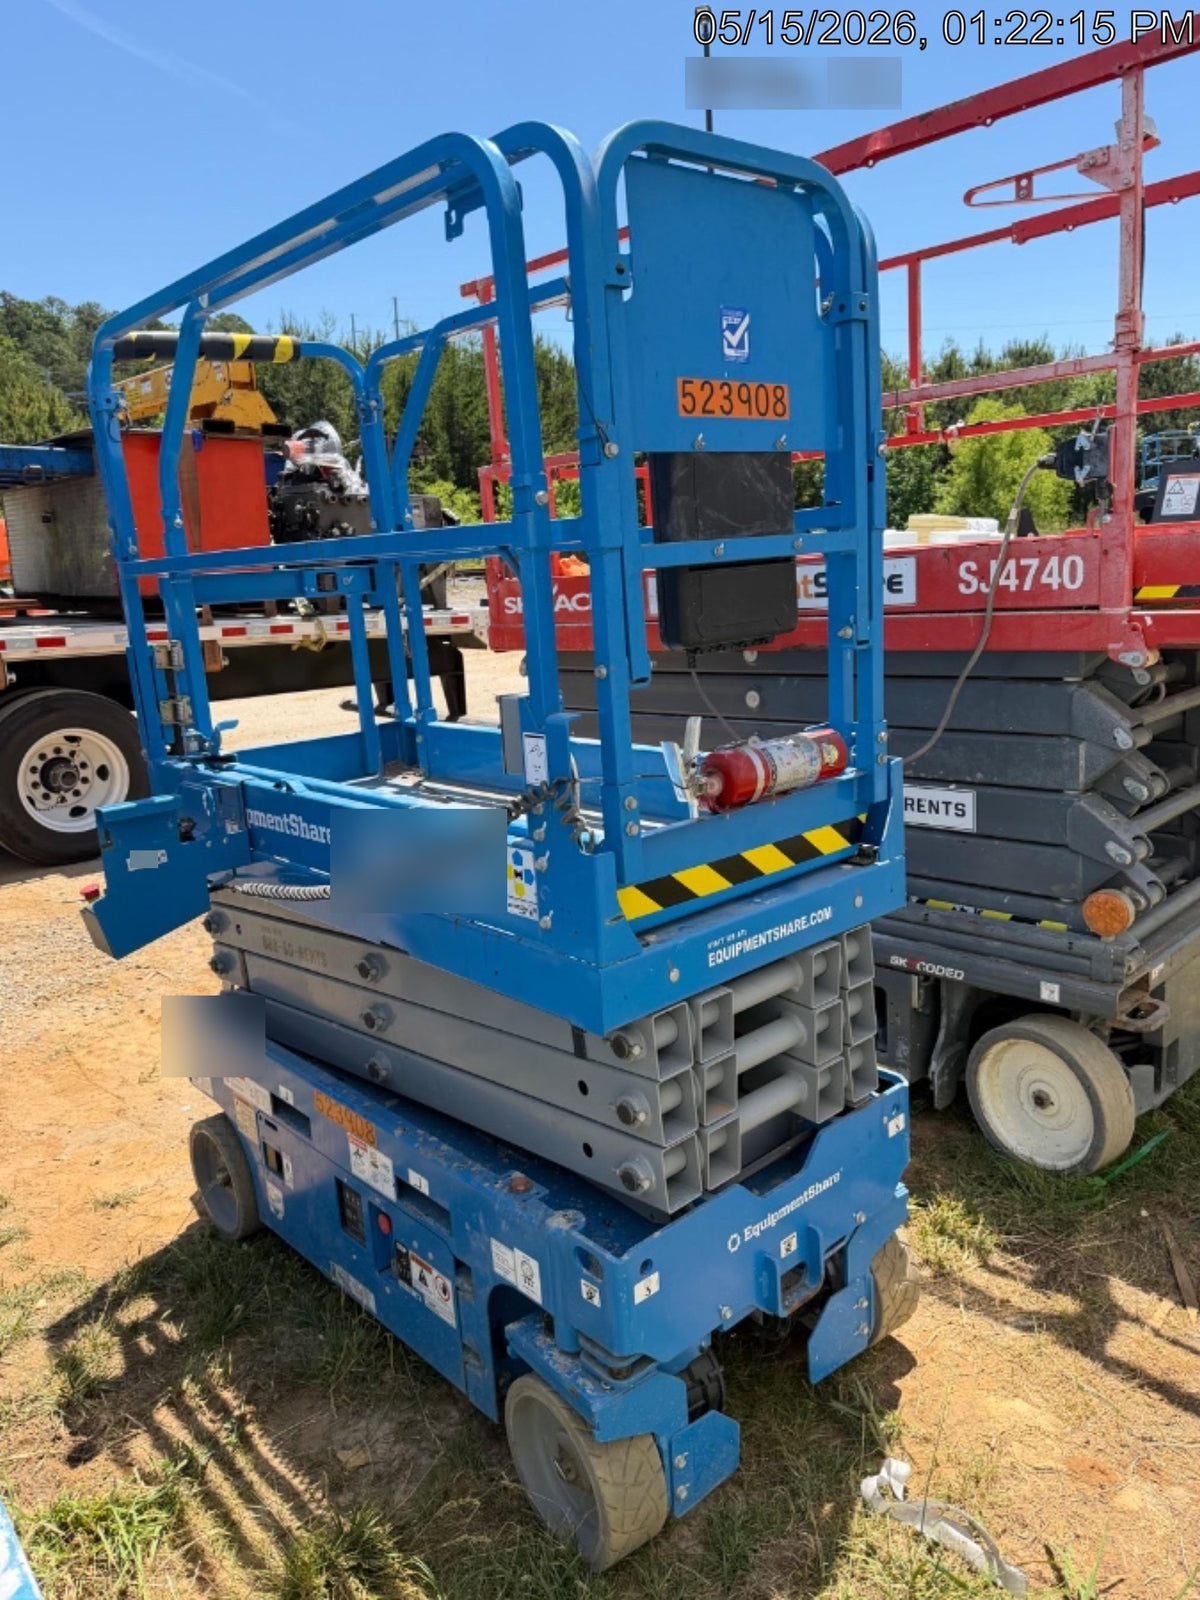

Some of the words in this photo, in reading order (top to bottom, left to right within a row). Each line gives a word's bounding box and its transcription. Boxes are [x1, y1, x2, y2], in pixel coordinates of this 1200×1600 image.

[681, 380, 787, 418] 523908
[958, 555, 1084, 595] SJ4740
[707, 906, 833, 968] EQUIPMENTSHARE.COM
[743, 1170, 841, 1242] EquipmentShare
